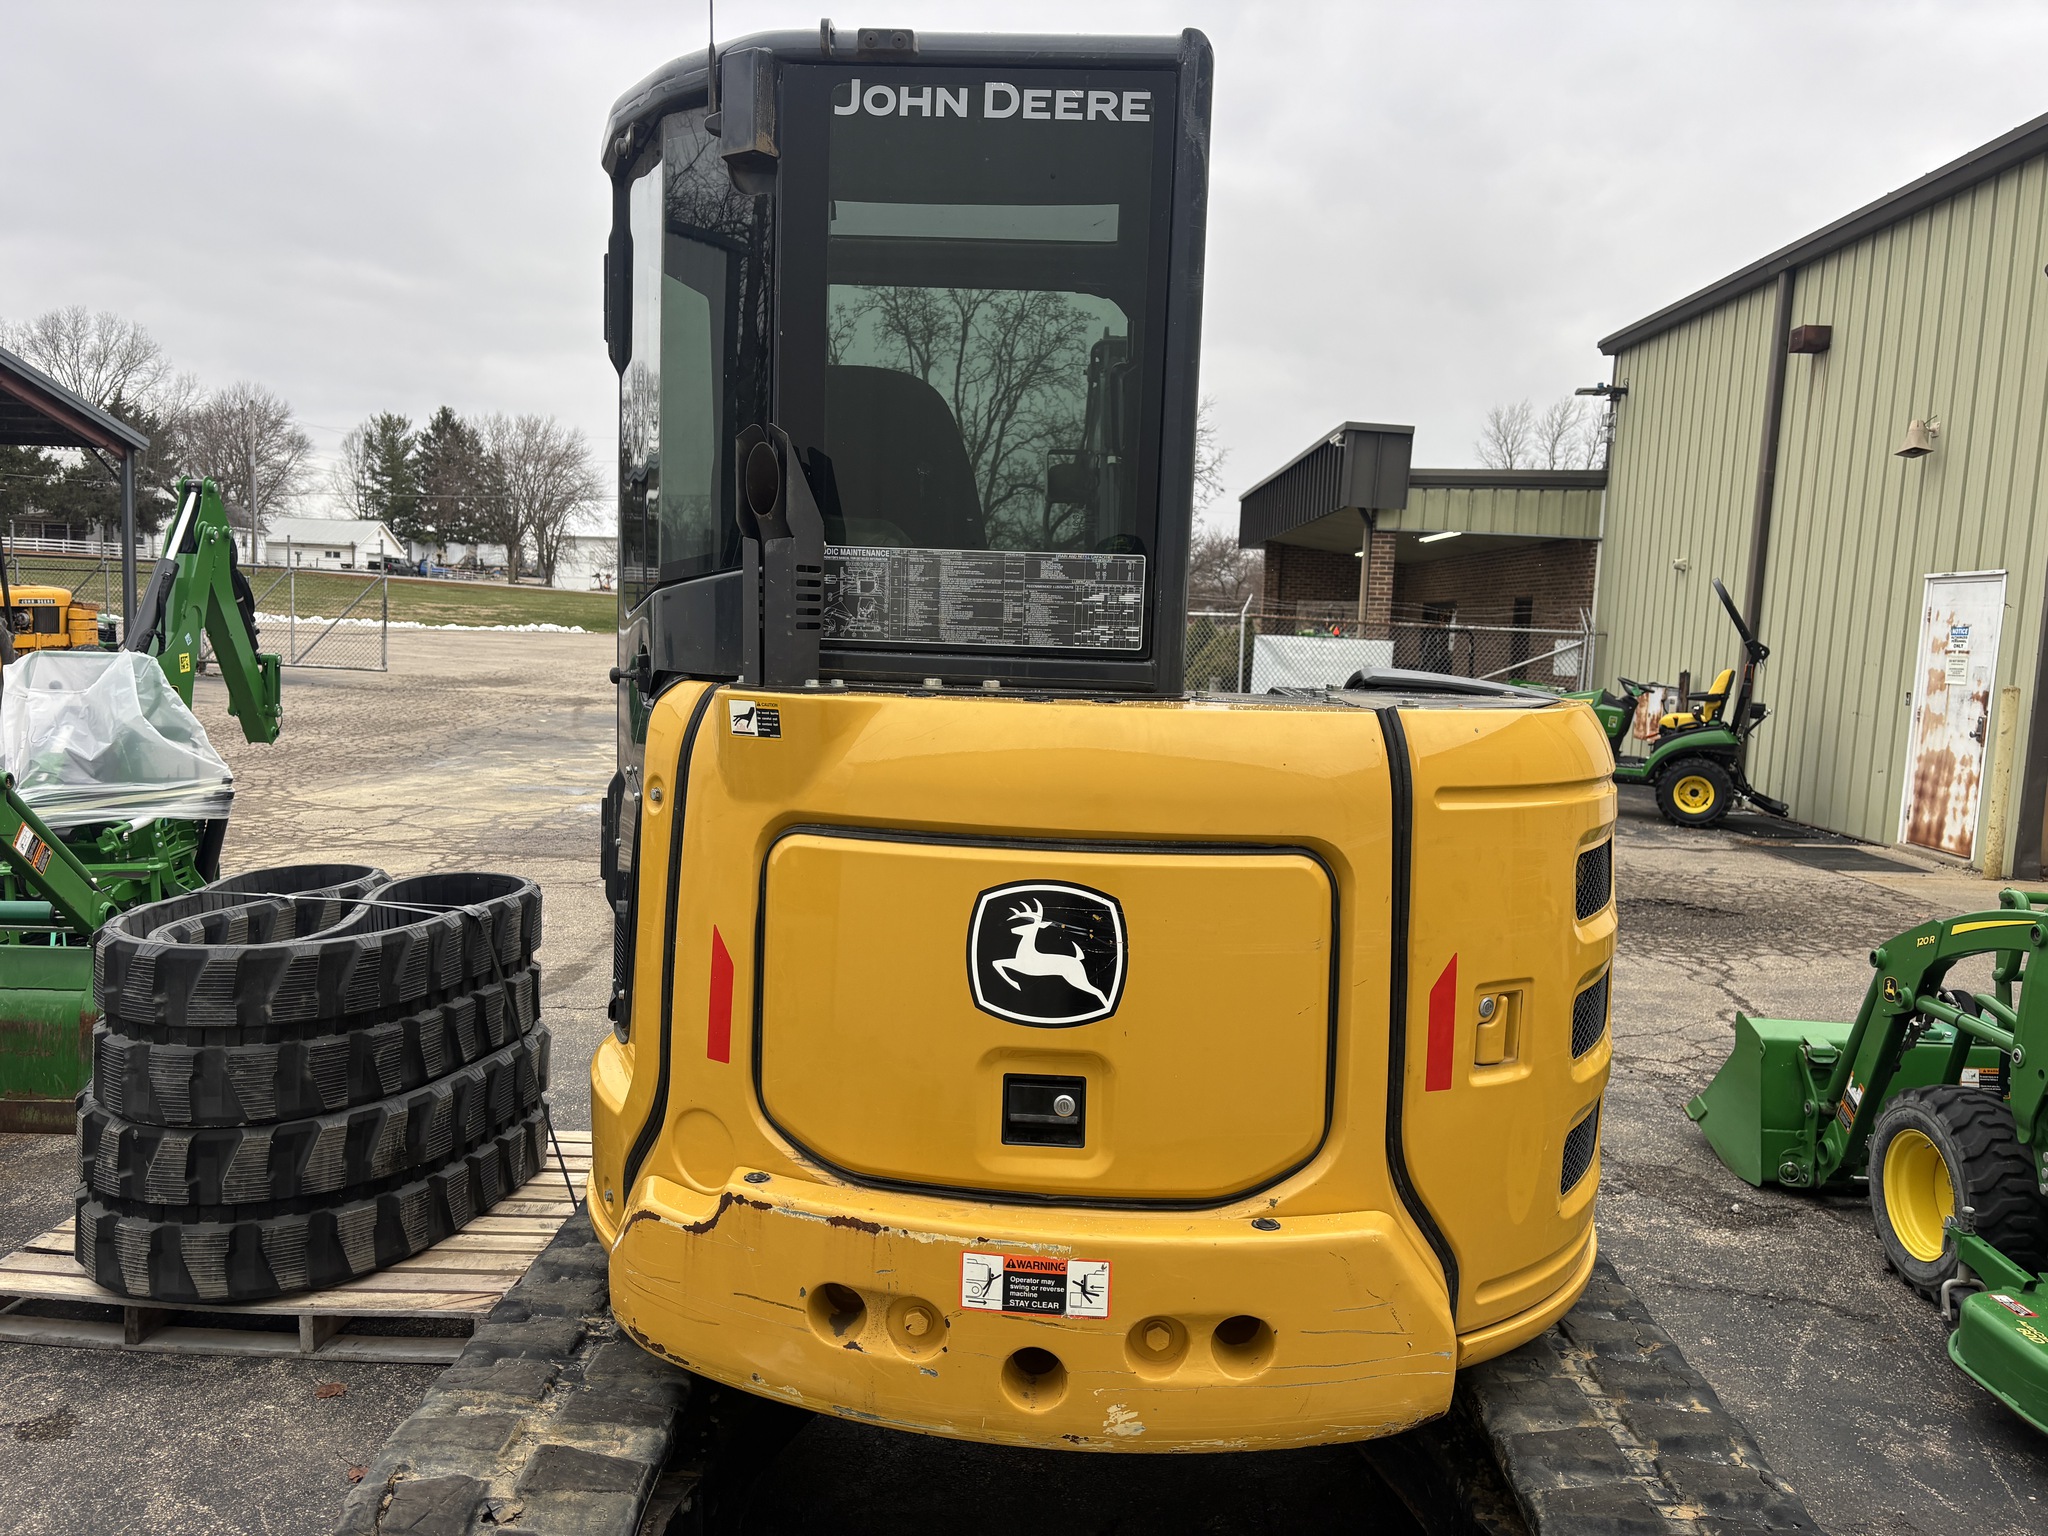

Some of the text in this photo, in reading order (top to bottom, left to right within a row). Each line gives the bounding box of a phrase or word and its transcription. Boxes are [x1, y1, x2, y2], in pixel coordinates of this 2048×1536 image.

[834, 79, 1152, 122] JOHN DEERE
[840, 548, 890, 557] MAINTENANCE
[1016, 1259, 1066, 1272] WARNING
[1010, 1276, 1039, 1285] Operator
[1010, 1284, 1030, 1293] swing
[1009, 1290, 1038, 1298] machine
[1009, 1299, 1060, 1309] STAY CLEAR
